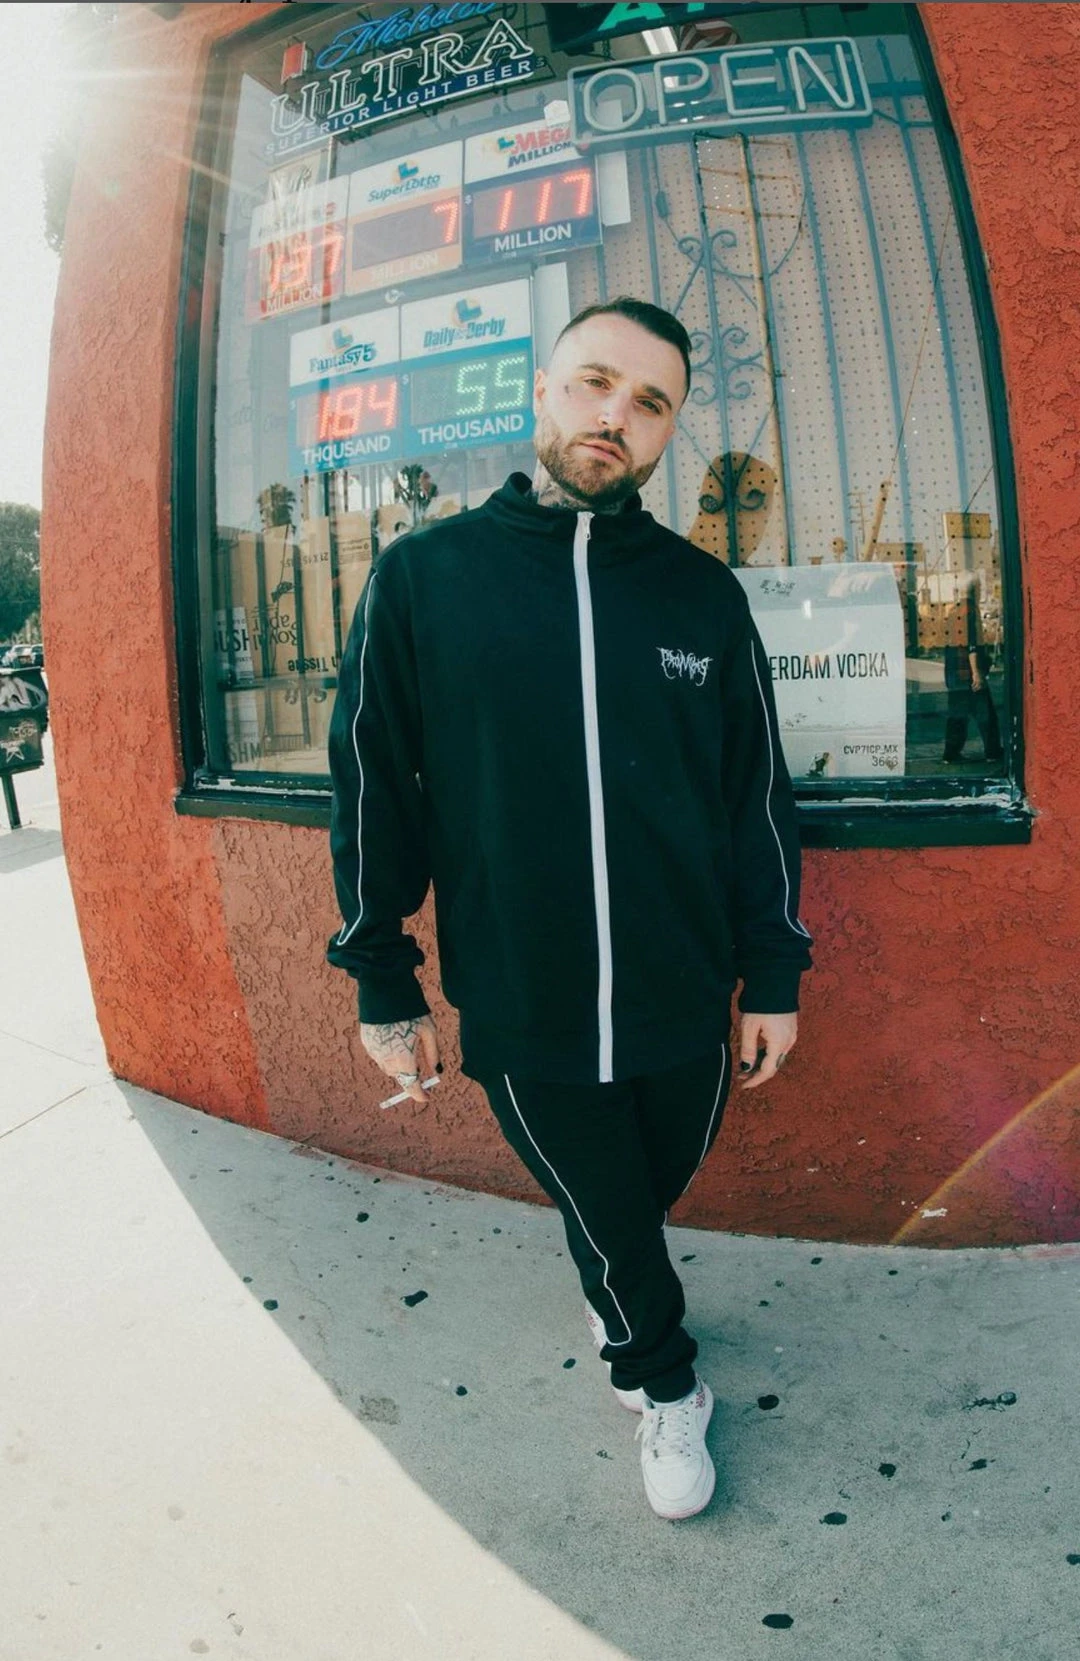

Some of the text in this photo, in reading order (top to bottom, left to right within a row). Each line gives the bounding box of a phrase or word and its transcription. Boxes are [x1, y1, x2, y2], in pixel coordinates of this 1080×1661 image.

[270, 18, 534, 137] ULTRA
[583, 44, 855, 131] OPEN
[266, 60, 532, 154] SUPERIOR LIGHT BEER
[508, 141, 574, 168] MILLION
[368, 174, 440, 202] SuperLotto
[498, 168, 591, 233] 117
[433, 201, 459, 244] 7
[494, 222, 572, 253] MILLION
[374, 250, 438, 282] MILLION
[423, 316, 505, 348] Daily Derby
[456, 355, 525, 416] 55
[318, 380, 397, 441] 184
[418, 414, 524, 445] THOUSAND
[302, 435, 391, 465] THOUSAND
[252, 630, 298, 651] Royl
[769, 652, 889, 681] ERDAM VODKA
